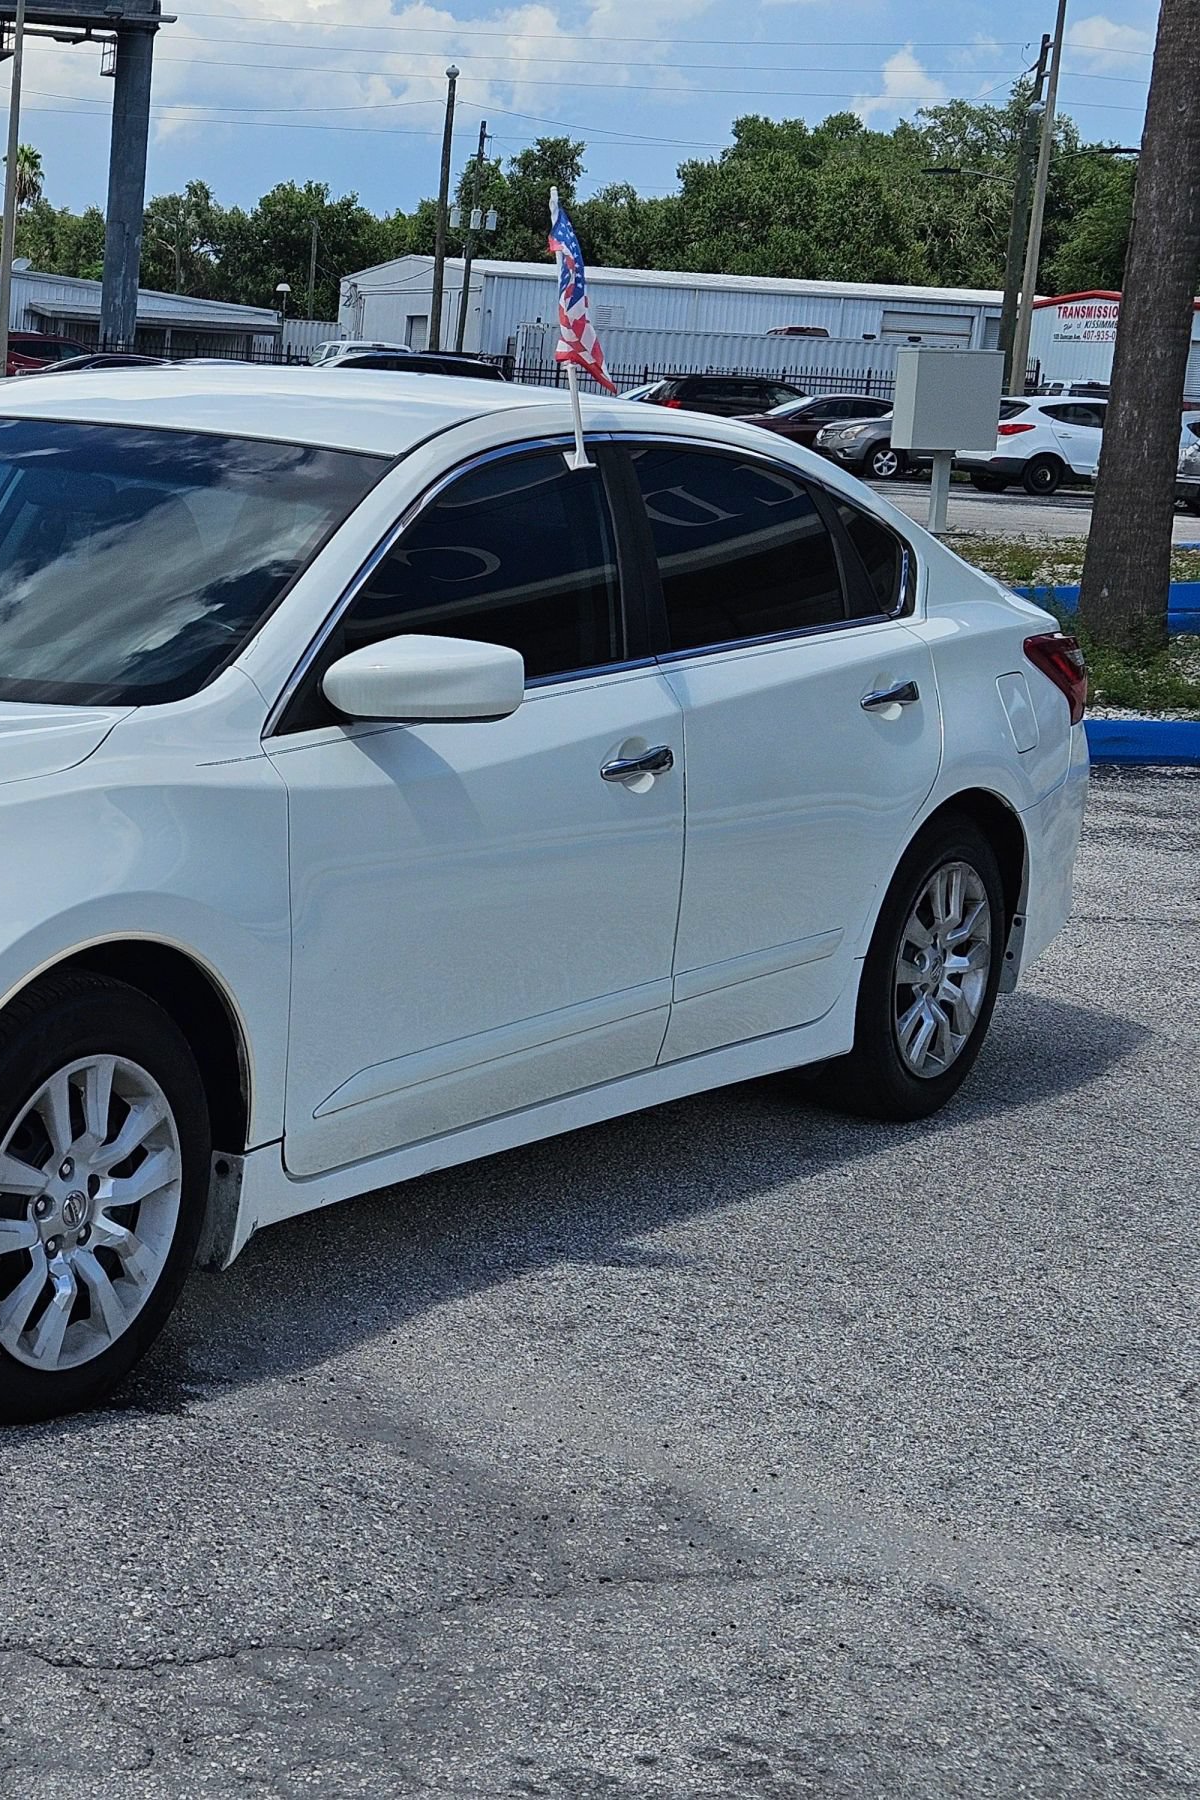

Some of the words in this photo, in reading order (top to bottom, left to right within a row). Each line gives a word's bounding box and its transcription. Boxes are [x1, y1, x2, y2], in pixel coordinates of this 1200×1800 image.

[1057, 305, 1119, 319] TRANSMISSIO
[1083, 320, 1118, 330] KISSIMME
[1082, 329, 1116, 341] 407-935-0
